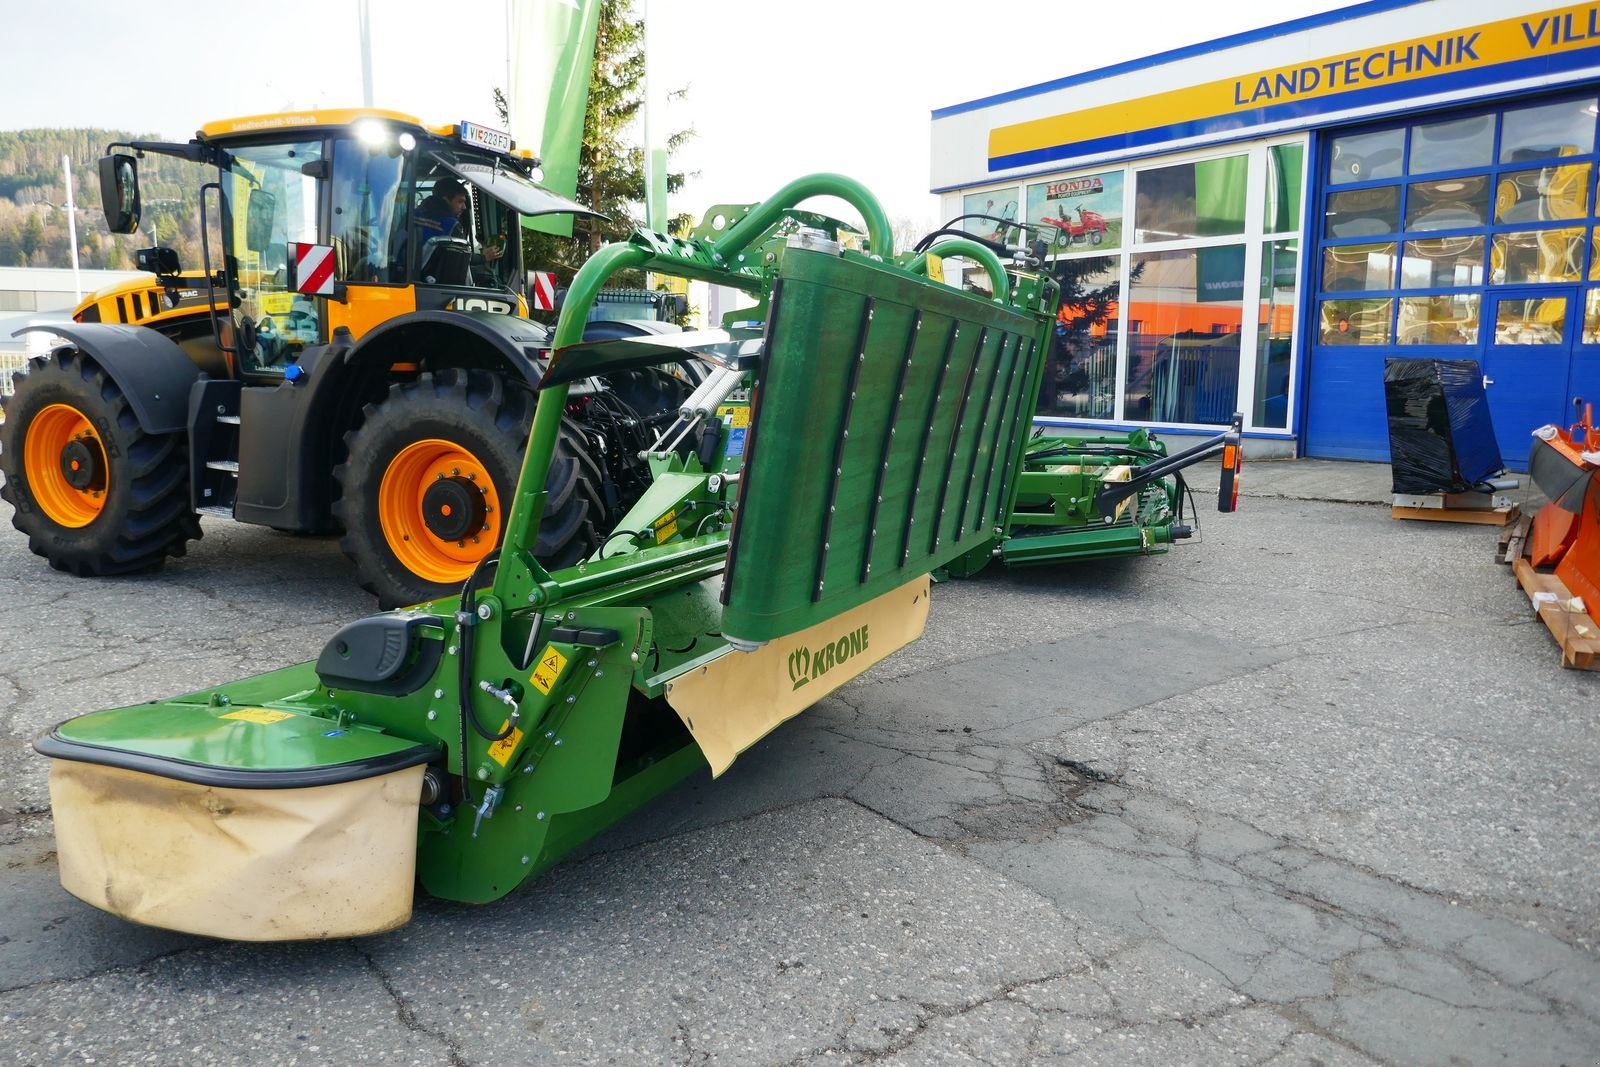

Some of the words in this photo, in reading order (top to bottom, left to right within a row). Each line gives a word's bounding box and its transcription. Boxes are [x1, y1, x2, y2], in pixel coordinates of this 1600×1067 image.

[1234, 32, 1481, 106] LANDTECHNIK
[1047, 178, 1103, 193] HONDA
[812, 624, 869, 680] KRONE
